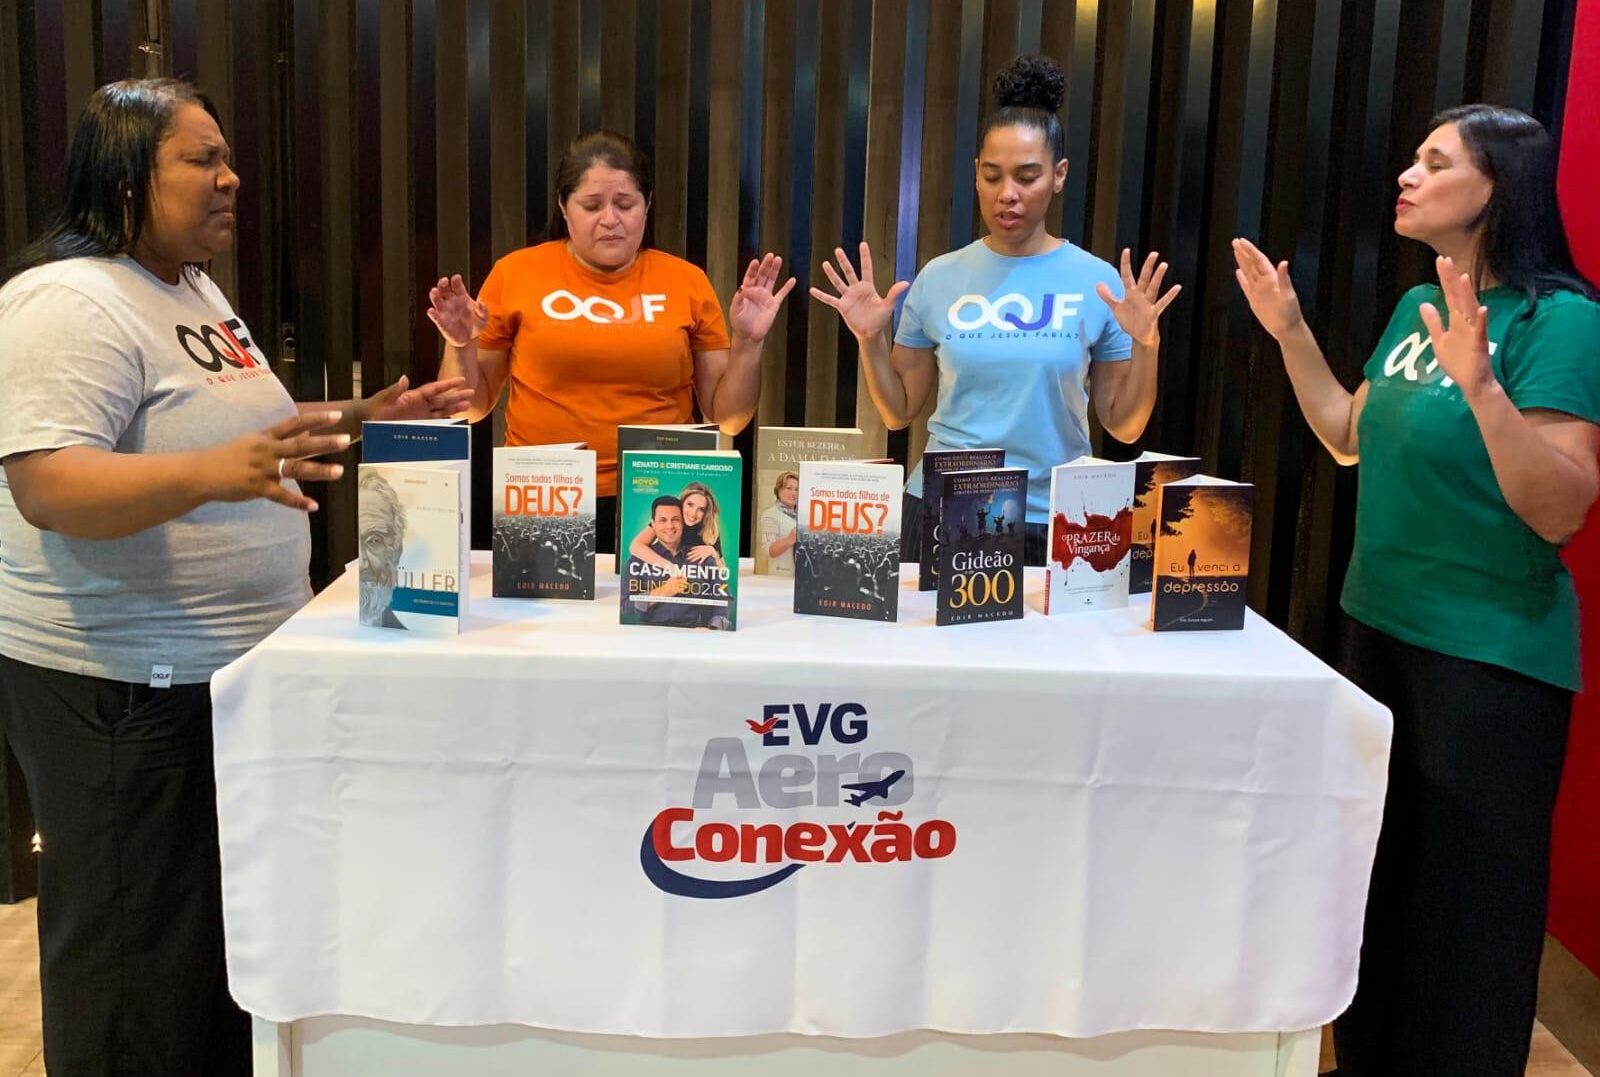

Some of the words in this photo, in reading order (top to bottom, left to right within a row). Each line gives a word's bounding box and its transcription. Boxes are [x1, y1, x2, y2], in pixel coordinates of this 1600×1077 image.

[948, 293, 1084, 331] OQJF
[777, 439, 805, 448] ESTER
[807, 441, 846, 451] BEZERRA
[632, 460, 659, 468] RENATO
[666, 462, 700, 470] CRISTIANE
[701, 464, 734, 472] CARDOSO
[505, 473, 530, 483] Somos
[531, 474, 552, 483] todos
[553, 474, 573, 484] filhos
[574, 475, 584, 484] de
[505, 485, 583, 517] DEUS?
[810, 486, 835, 497] Somos
[836, 488, 857, 499] todos
[859, 490, 879, 501] filhos
[880, 492, 890, 501] de
[808, 499, 889, 535] DEUS?
[1066, 543, 1111, 557] Vingança
[952, 550, 1014, 571] Gideão
[1170, 563, 1185, 572] Eu
[1198, 562, 1229, 572] venci
[1233, 563, 1241, 571] a
[629, 562, 730, 580] CASAMENTO
[949, 569, 1015, 608] 300
[1163, 581, 1239, 595] depressão
[818, 599, 837, 608] EDIR
[840, 600, 872, 611] MACEDO
[763, 703, 868, 746] EVG
[692, 737, 914, 809] Aero
[652, 808, 957, 864] Conexão
